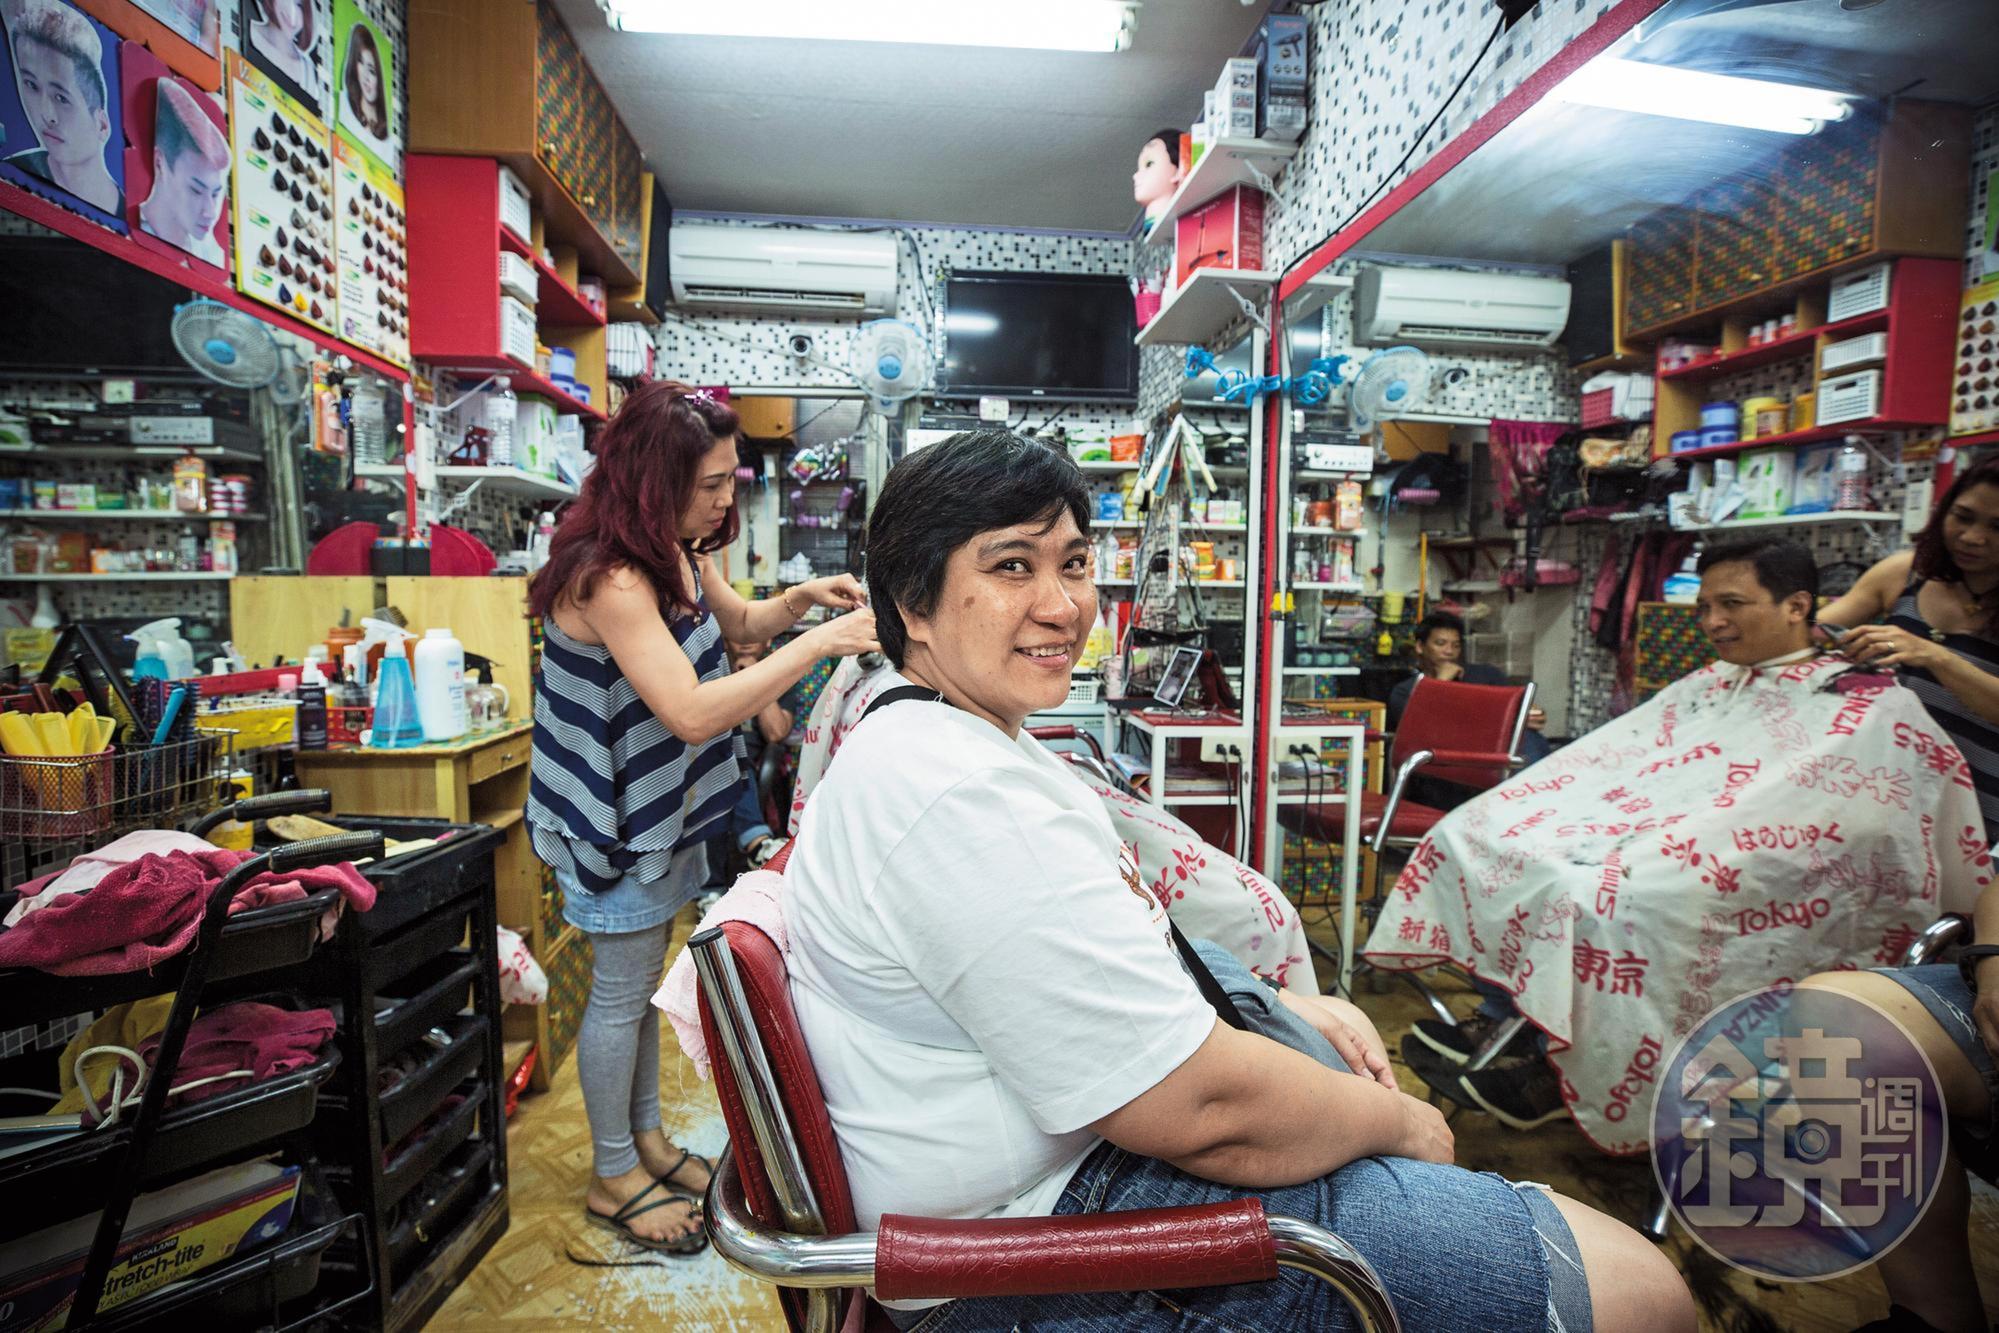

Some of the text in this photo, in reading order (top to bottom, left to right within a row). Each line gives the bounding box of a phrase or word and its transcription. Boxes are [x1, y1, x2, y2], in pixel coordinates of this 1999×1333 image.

[1499, 774, 1575, 802] Tokyo
[1397, 916, 1452, 952] 新宿
[1732, 897, 1832, 938] Tokyo
[1572, 938, 1650, 999] 東京
[1720, 976, 1796, 1044] GINZA
[1604, 1032, 1664, 1123] Tokyo
